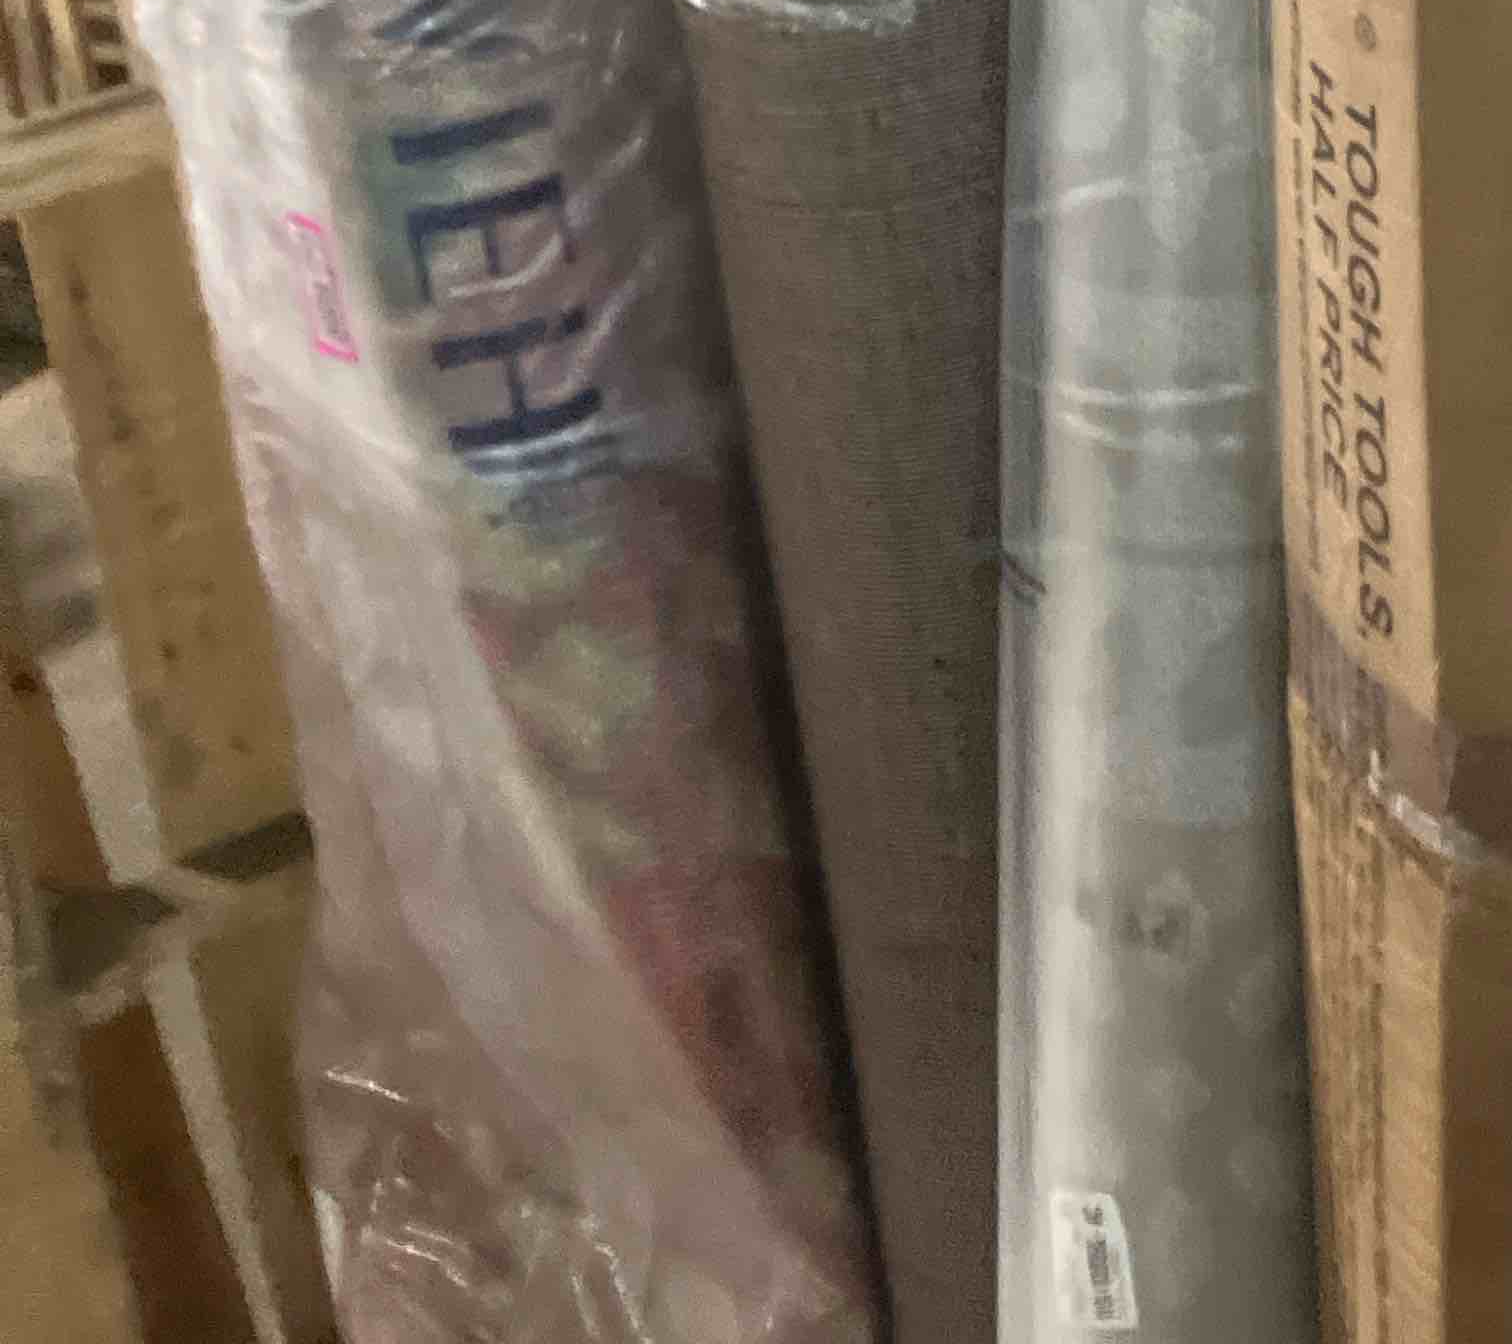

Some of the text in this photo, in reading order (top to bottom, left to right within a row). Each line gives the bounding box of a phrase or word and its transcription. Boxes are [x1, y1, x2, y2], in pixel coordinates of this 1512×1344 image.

[1308, 58, 1349, 513] HALF PRICE
[1344, 104, 1384, 372] TOUGH
